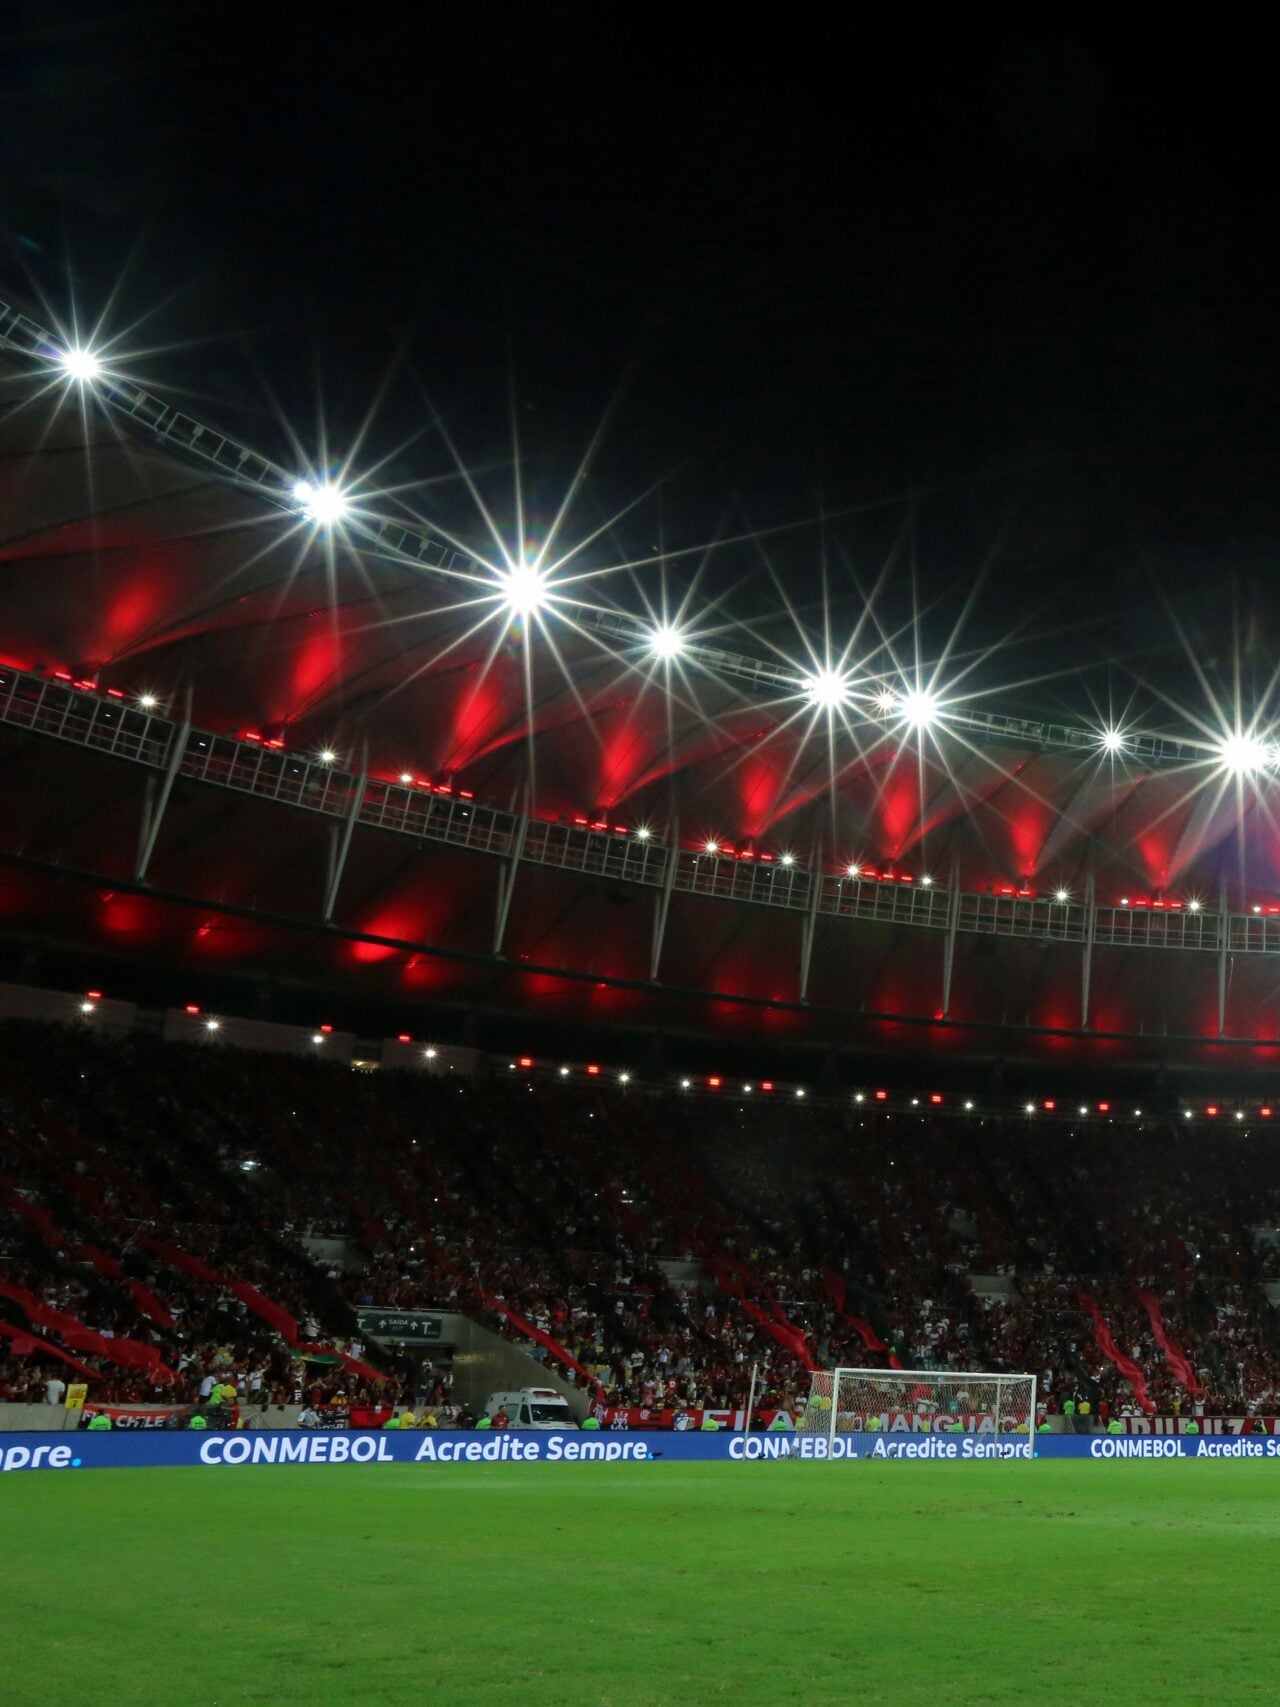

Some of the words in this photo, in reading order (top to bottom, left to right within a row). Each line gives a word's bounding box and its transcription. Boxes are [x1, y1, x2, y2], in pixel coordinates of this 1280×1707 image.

[0, 1445, 82, 1471] pre.
[199, 1436, 394, 1464] CONMEBOL
[414, 1434, 540, 1461] Acredite
[545, 1436, 655, 1461] Sempre.
[728, 1436, 858, 1460] CONMEBOL
[871, 1436, 958, 1459] Acredite
[961, 1438, 1039, 1459] Sempre.
[1090, 1438, 1186, 1458] CONMEBOL
[1196, 1437, 1264, 1458] Acredite
